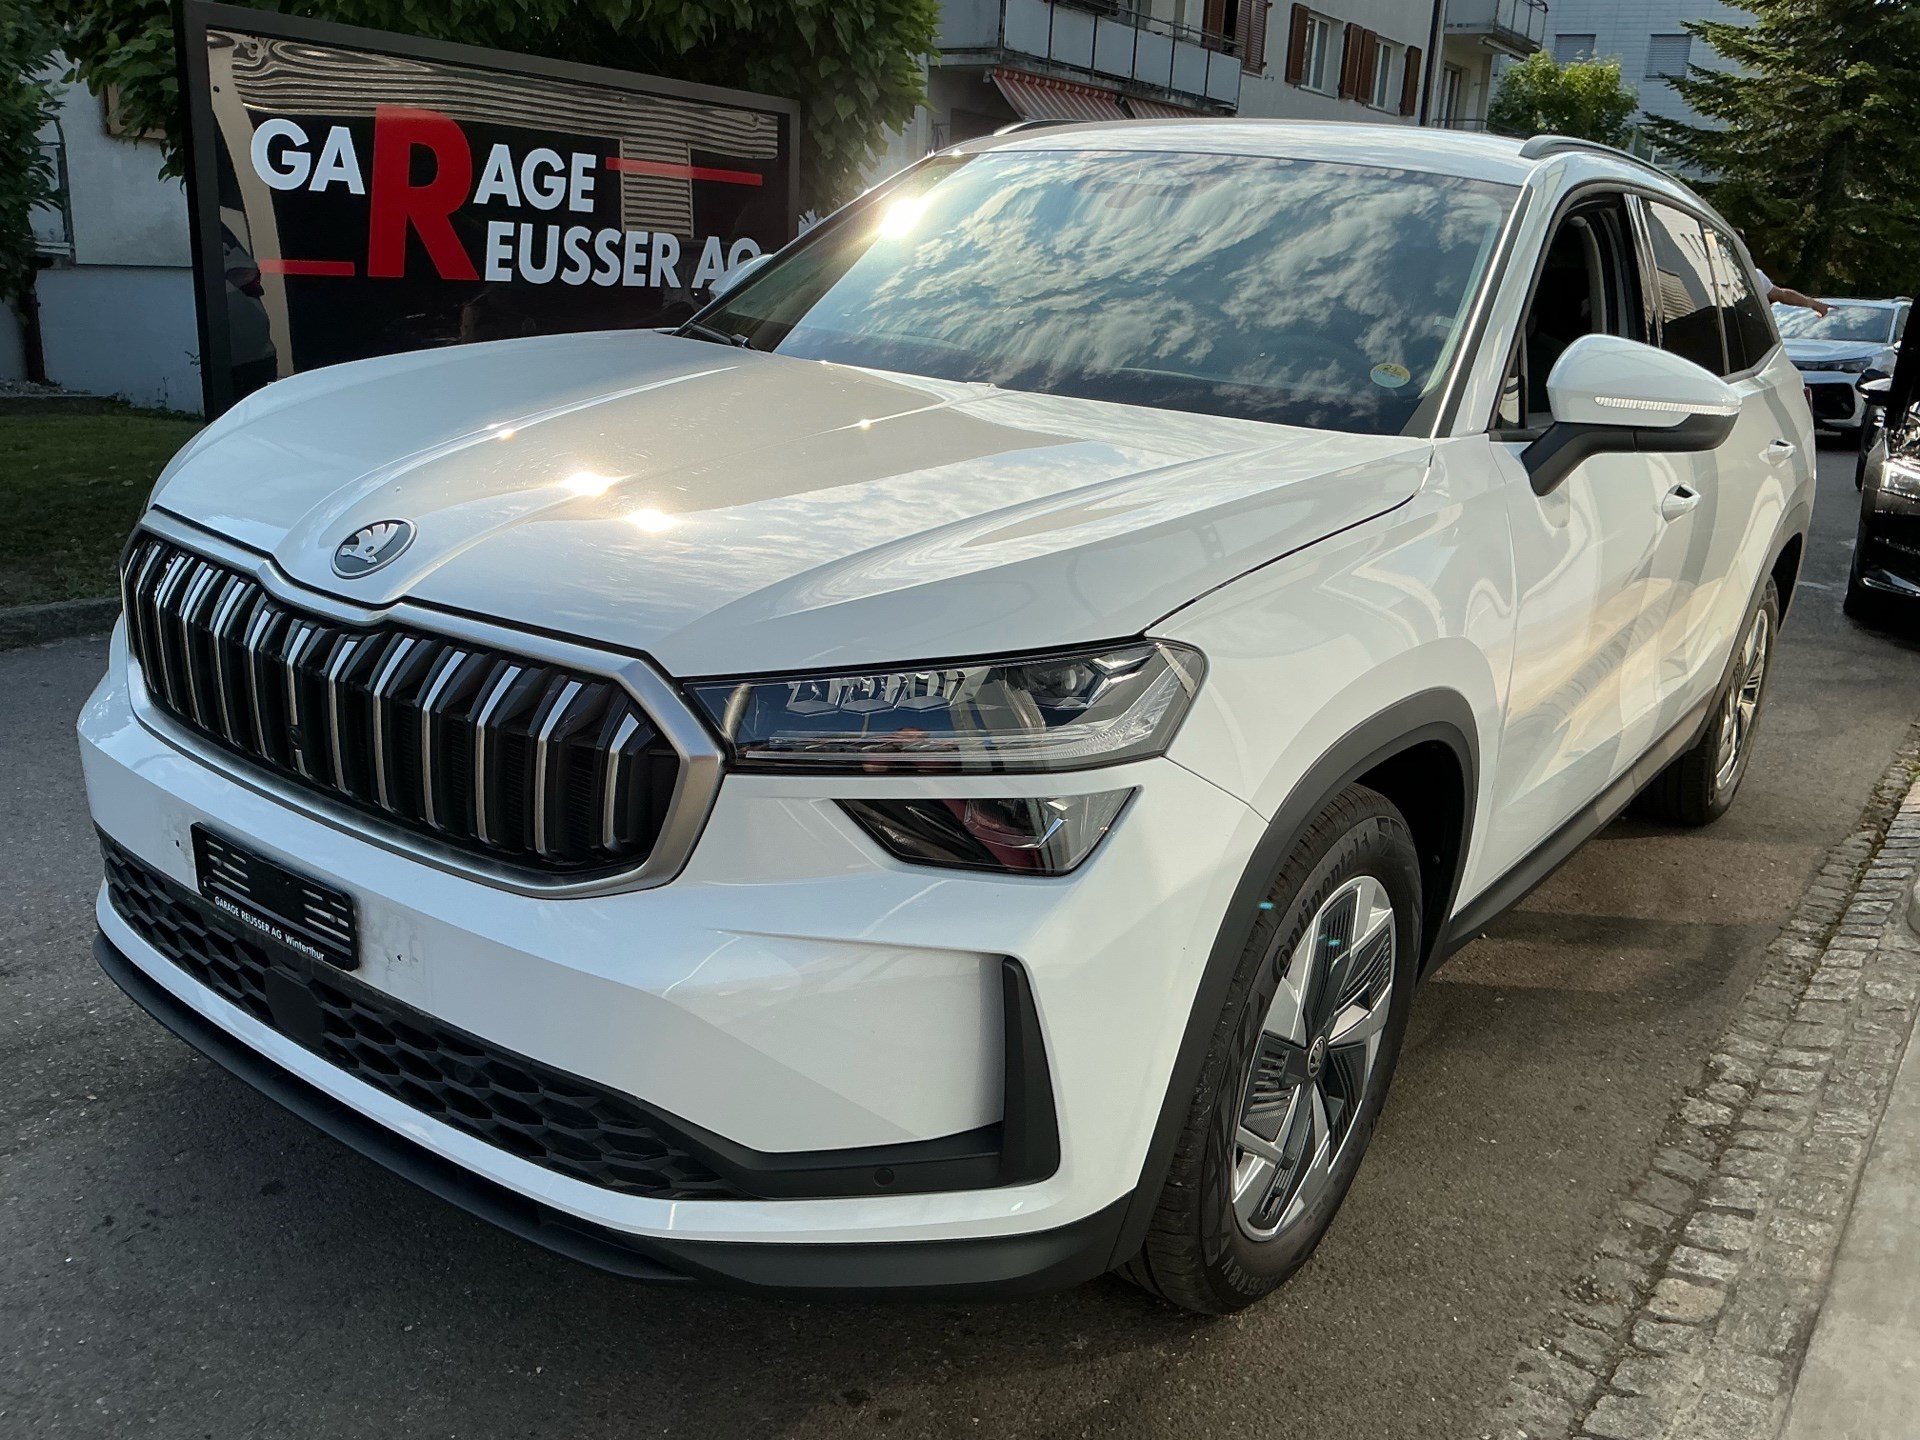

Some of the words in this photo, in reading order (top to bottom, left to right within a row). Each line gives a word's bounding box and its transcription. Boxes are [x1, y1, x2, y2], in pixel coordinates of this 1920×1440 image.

[250, 104, 597, 281] GARAGE
[214, 896, 240, 917] GARAGE
[240, 910, 271, 934] REUSSER
[271, 927, 283, 940] AG
[285, 933, 325, 961] Winterthur
[1271, 837, 1360, 984] Continental
